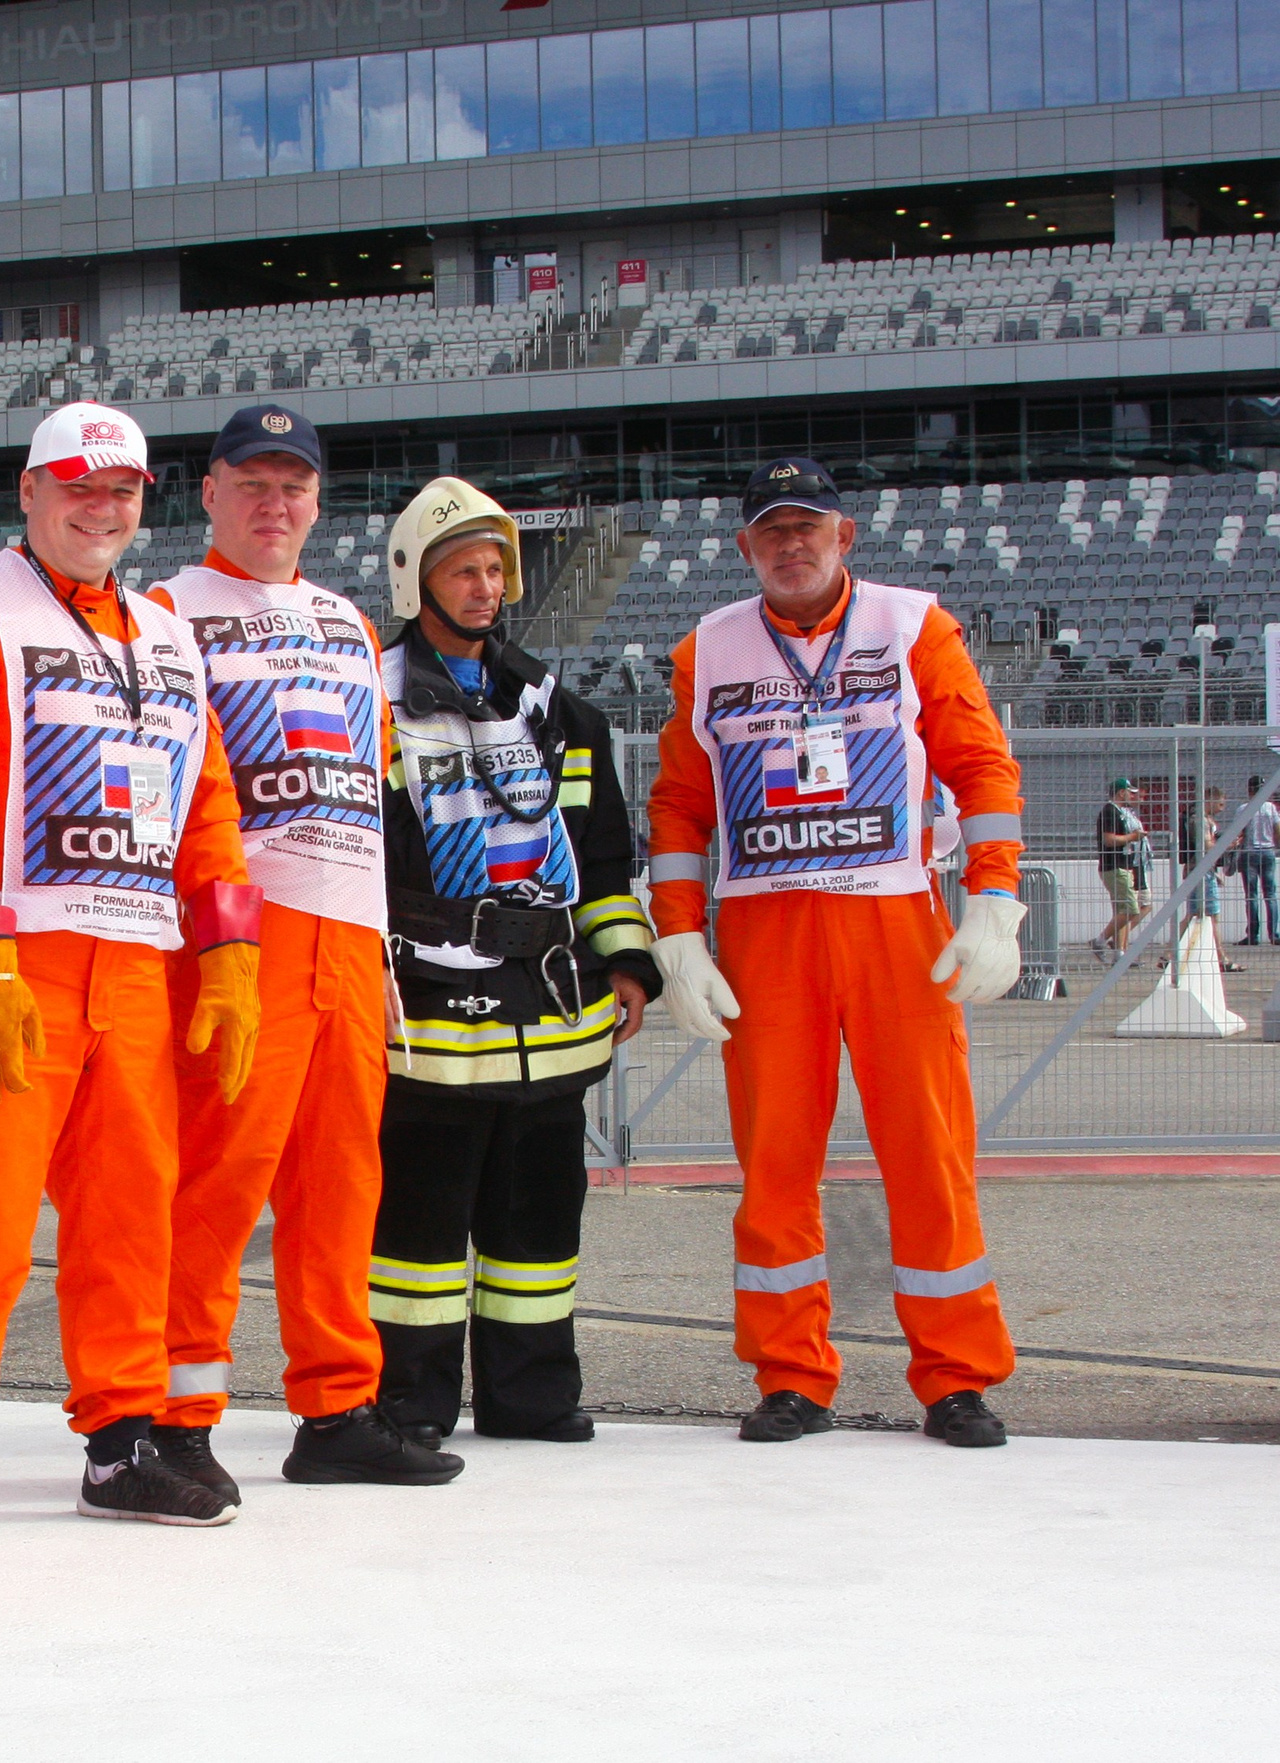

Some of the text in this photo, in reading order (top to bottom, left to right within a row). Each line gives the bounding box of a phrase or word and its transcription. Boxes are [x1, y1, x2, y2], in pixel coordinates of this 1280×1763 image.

[531, 269, 553, 278] 410
[621, 262, 641, 271] 411
[80, 421, 125, 441] ROS
[432, 499, 461, 524] 34
[513, 514, 535, 525] 10
[265, 657, 341, 674] TRACK MARSHAL
[844, 671, 897, 691] 2018
[94, 704, 128, 721] TRACK
[747, 719, 776, 733] CHIEF
[465, 748, 536, 777] RS1235
[251, 766, 377, 808] COURSE
[483, 797, 502, 810] FIR
[287, 824, 338, 839] FORMULA
[344, 833, 364, 844] 2018
[744, 815, 882, 855] COURSE
[332, 842, 363, 855] GRAND
[770, 875, 855, 890] FORMULA 1 2018
[856, 881, 879, 891] PRIX
[93, 894, 145, 910] FORMULA
[64, 903, 91, 915] VTB
[92, 905, 137, 919] RUSSIAN
